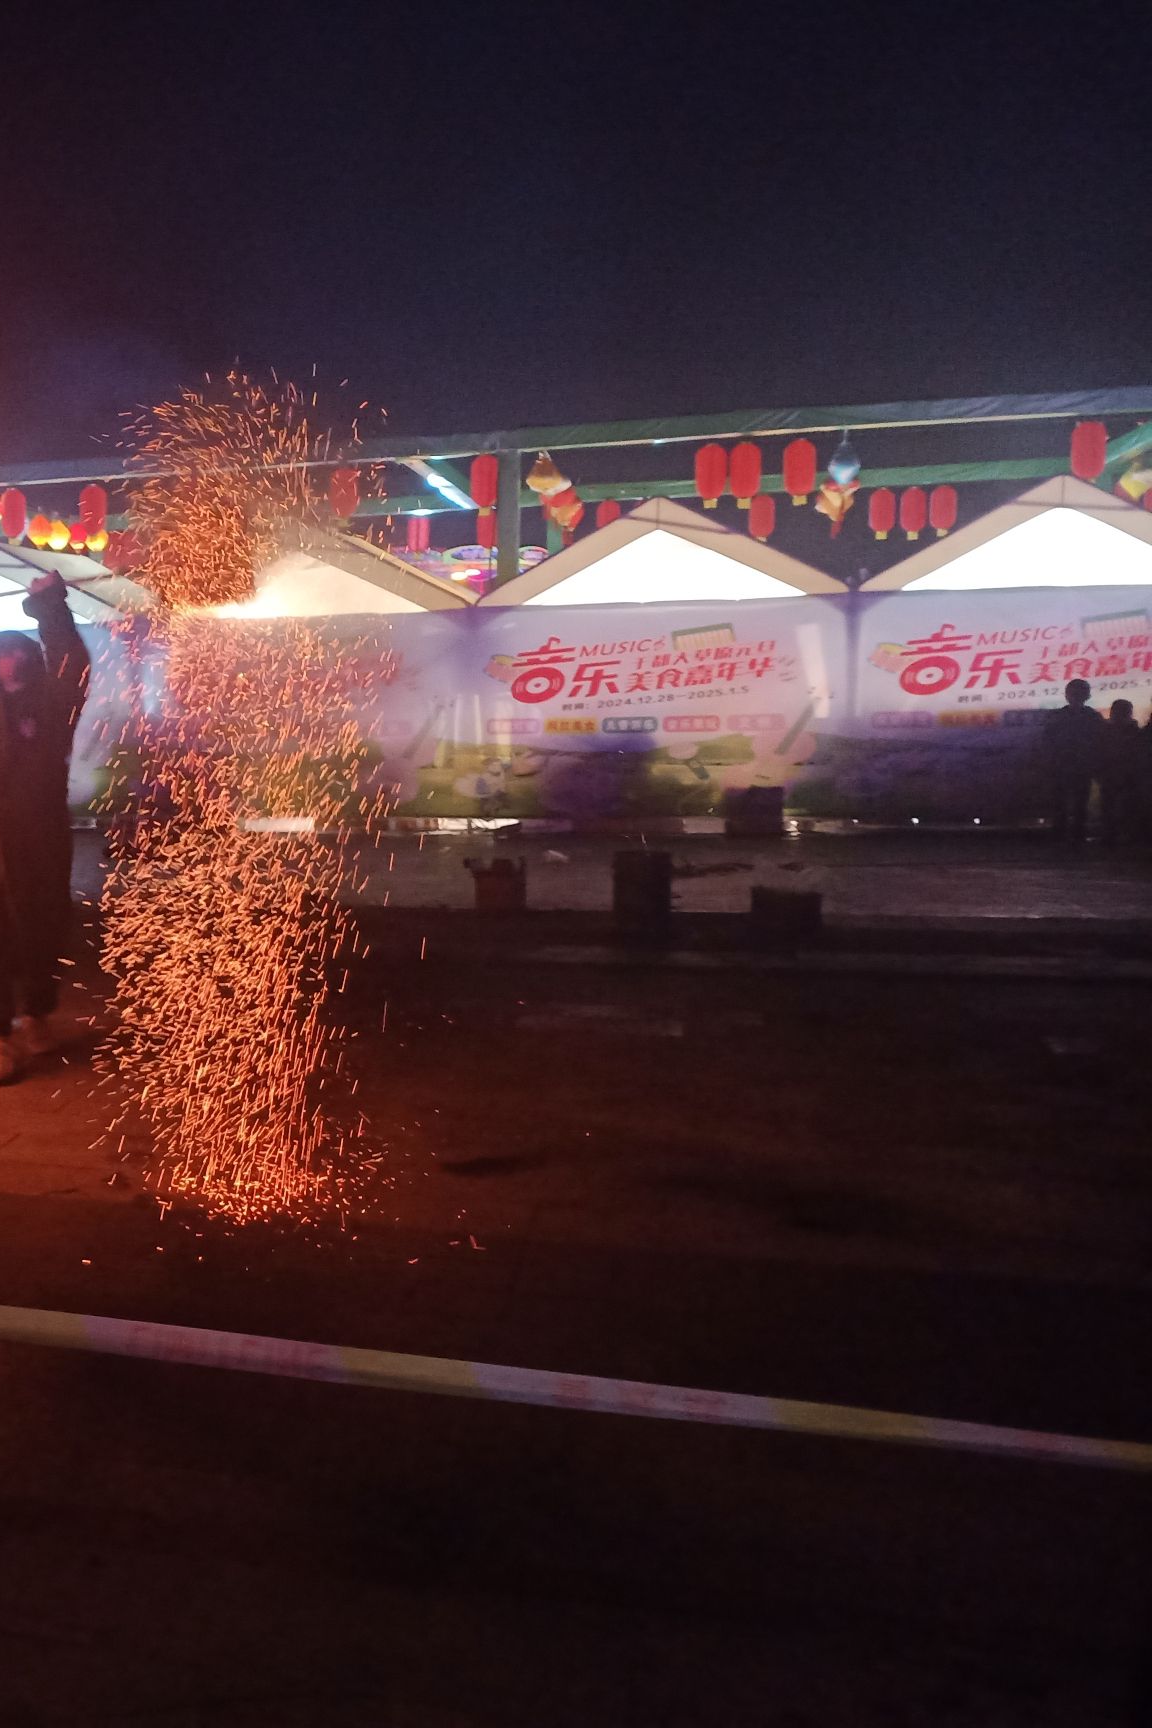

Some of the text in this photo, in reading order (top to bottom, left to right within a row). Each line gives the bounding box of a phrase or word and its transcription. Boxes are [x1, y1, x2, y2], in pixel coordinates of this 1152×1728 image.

[579, 639, 652, 659] MUSIC
[976, 625, 1057, 647] MUSIC
[511, 636, 621, 704] 音乐
[898, 623, 1024, 696] 音乐
